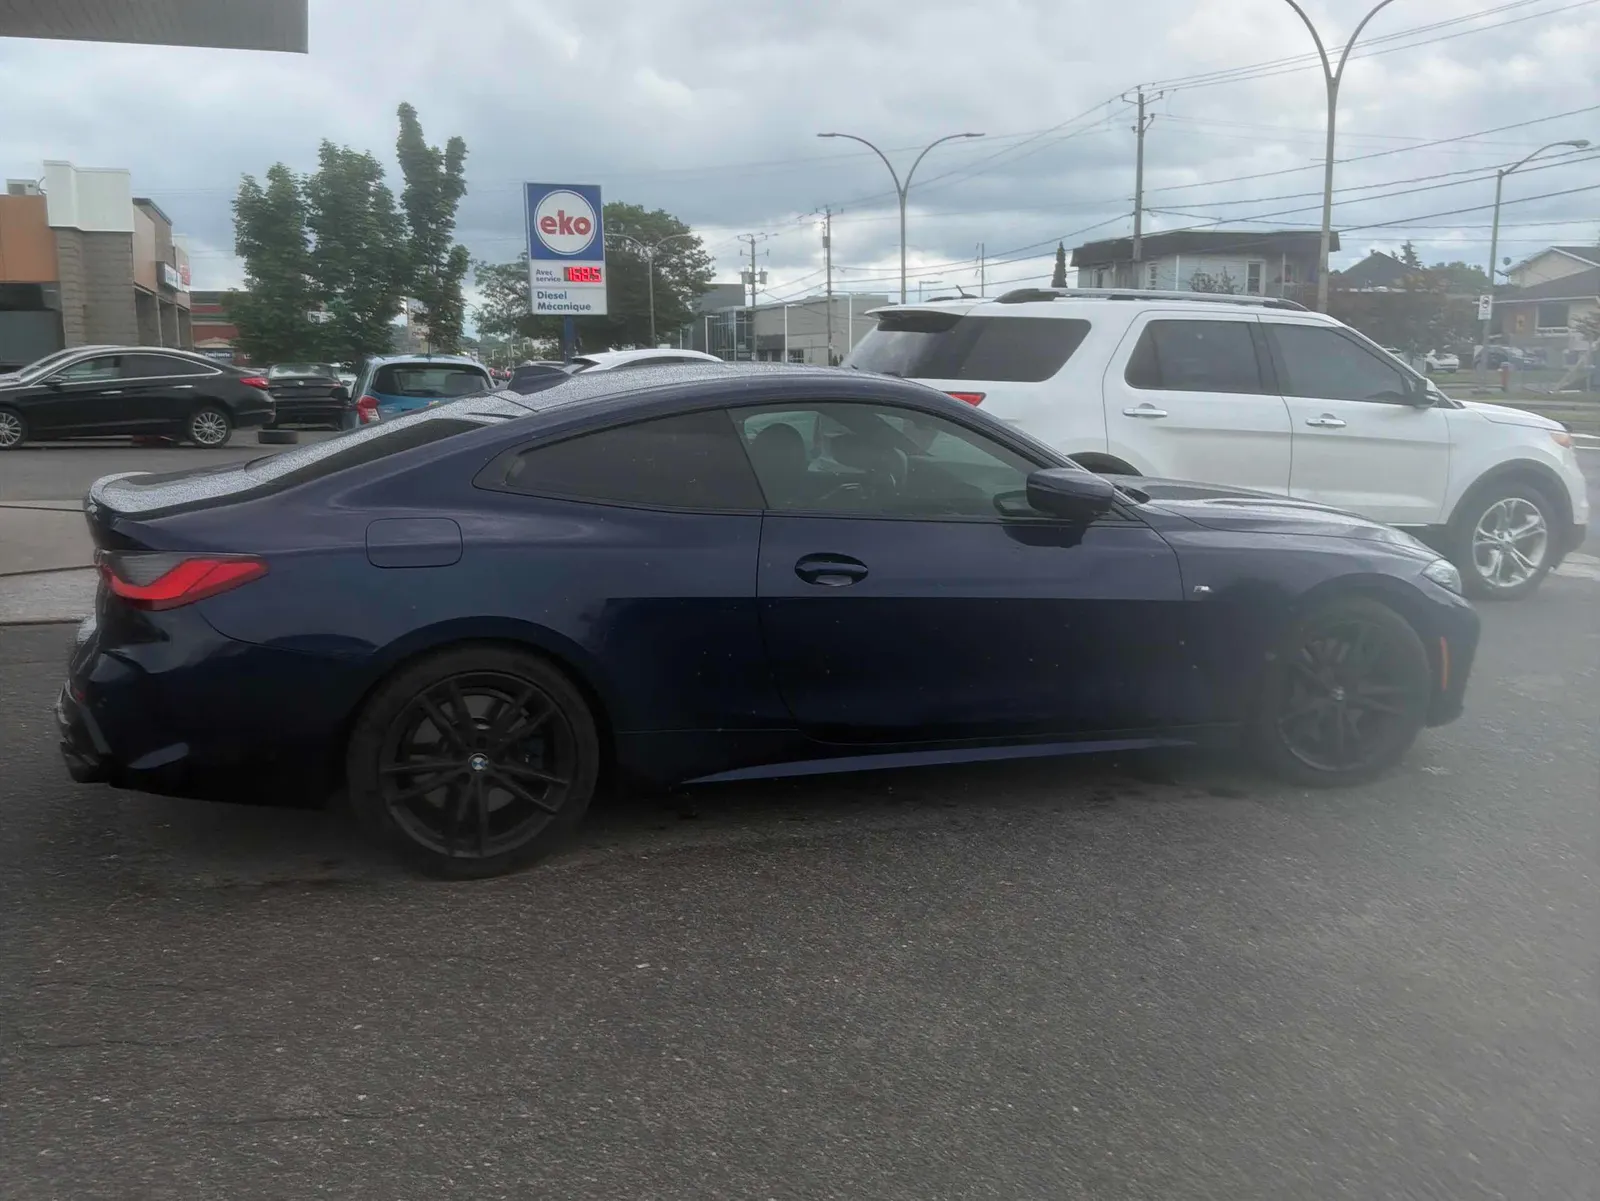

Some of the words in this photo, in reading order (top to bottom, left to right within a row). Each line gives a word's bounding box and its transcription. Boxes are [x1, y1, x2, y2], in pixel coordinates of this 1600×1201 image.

[540, 209, 592, 236] eko
[537, 291, 568, 300] Diesel
[537, 302, 592, 312] Mécanique
